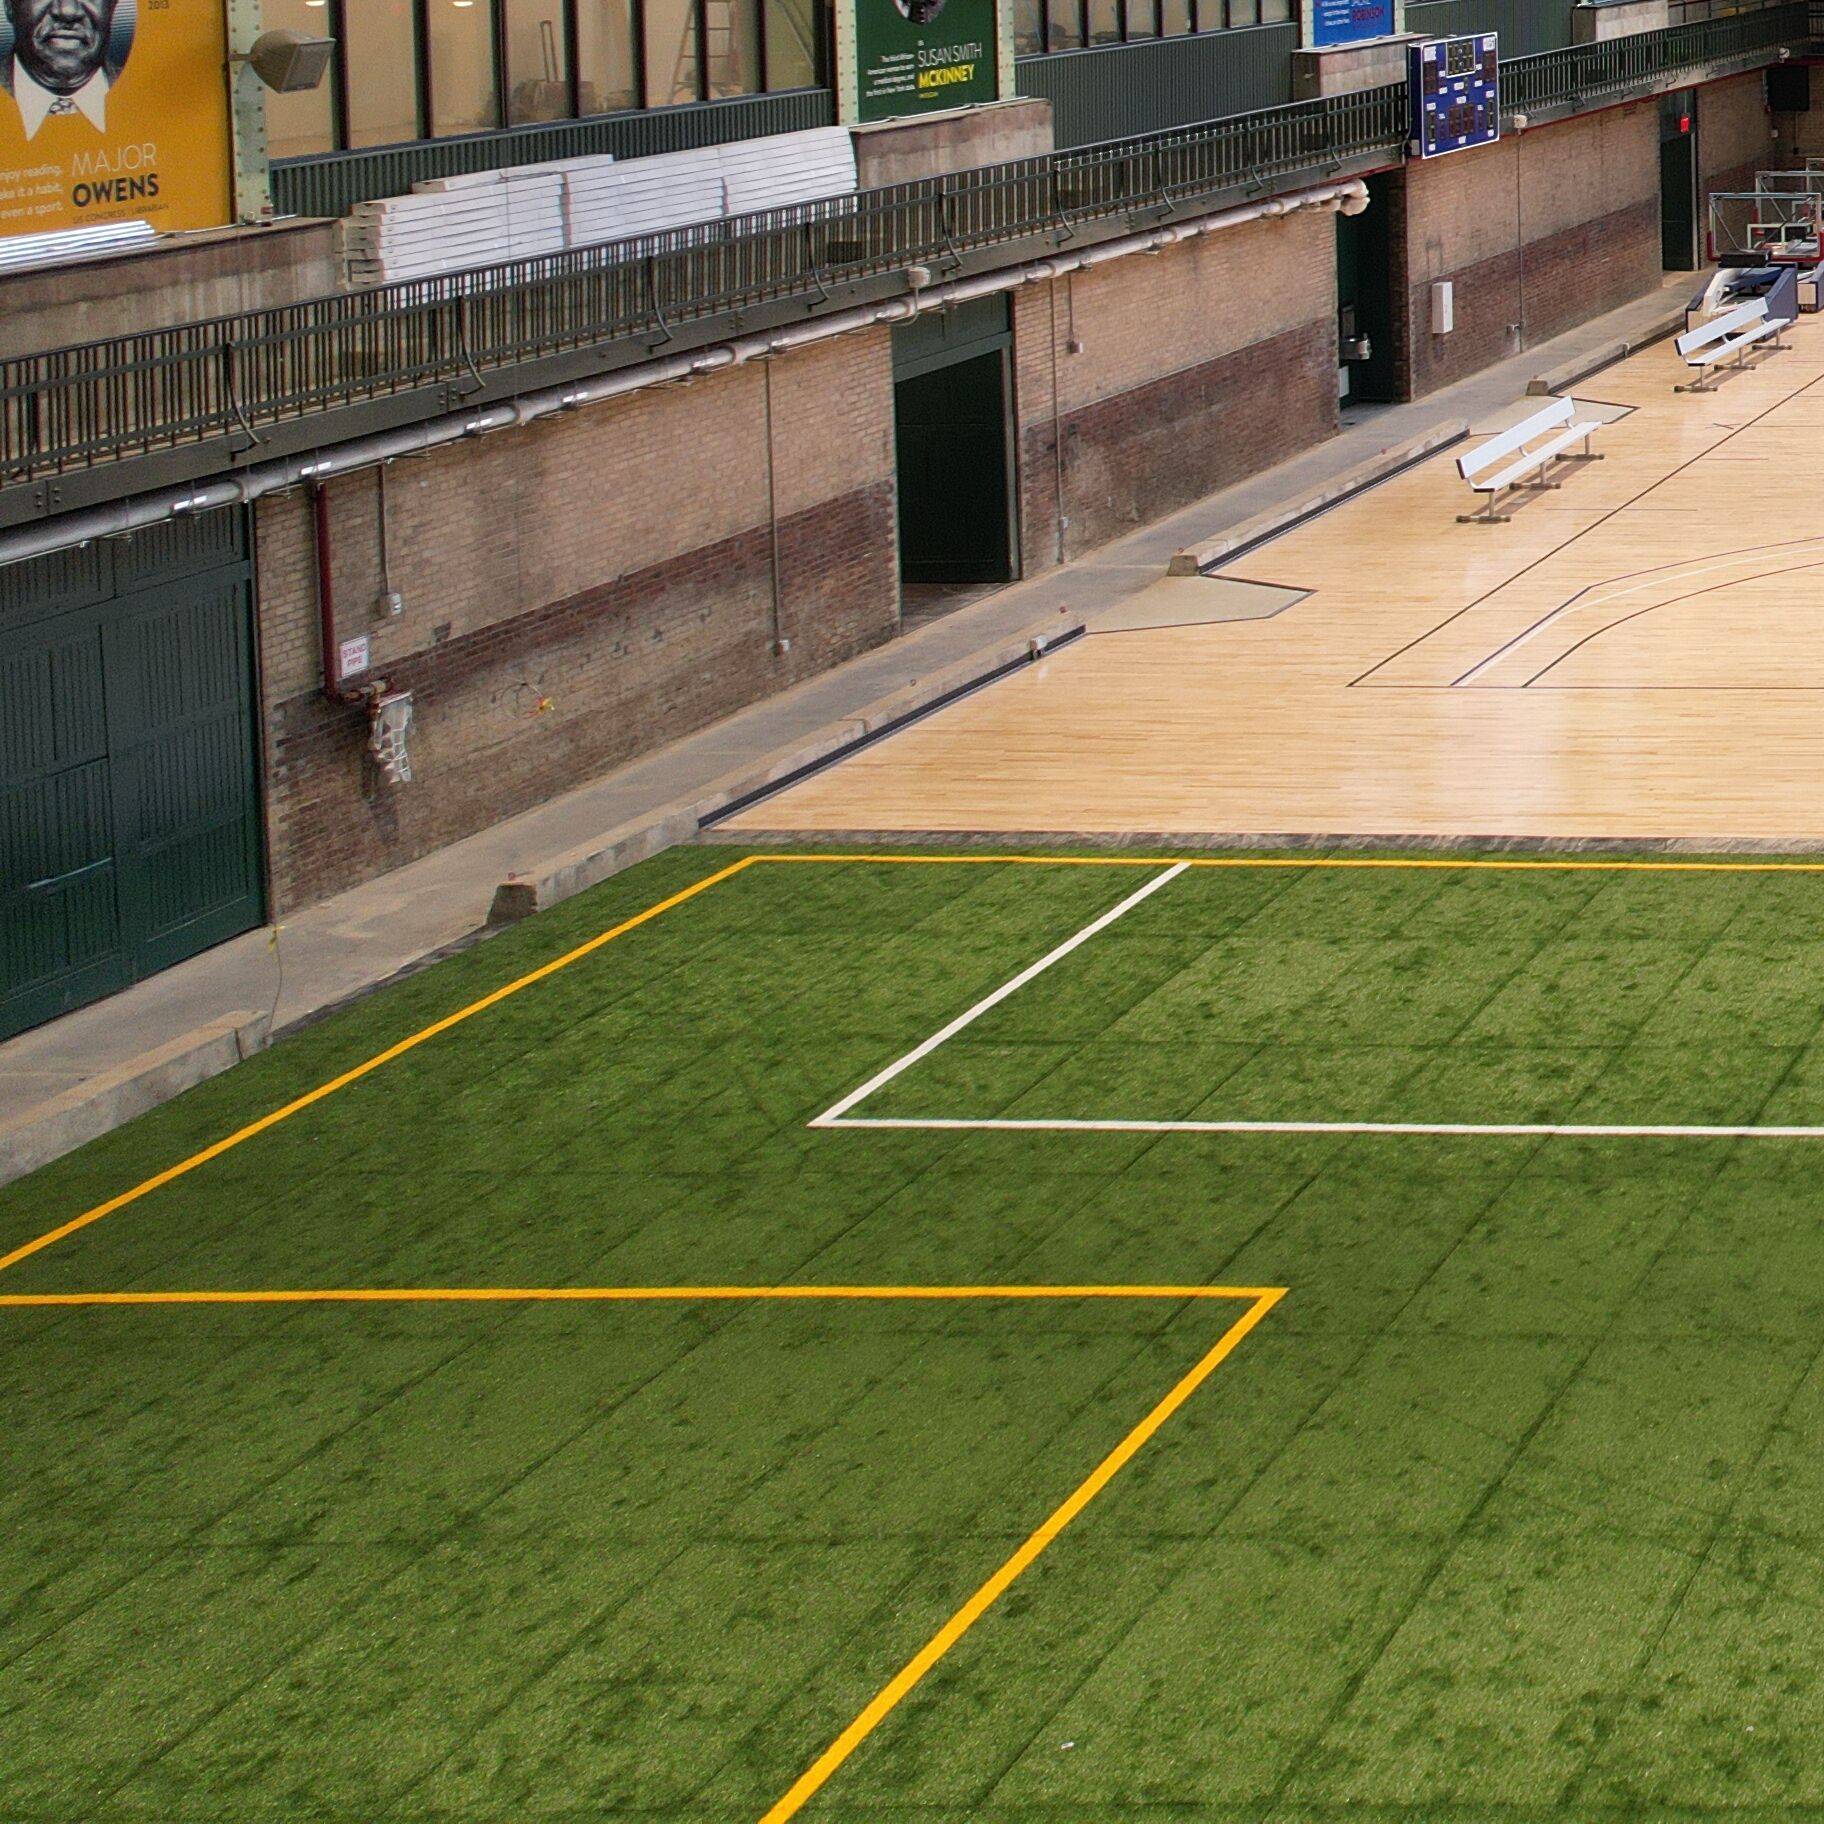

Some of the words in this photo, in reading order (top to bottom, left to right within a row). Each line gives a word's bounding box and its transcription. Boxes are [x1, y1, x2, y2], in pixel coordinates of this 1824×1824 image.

[918, 46, 952, 68] SUSAN
[952, 42, 982, 63] SMITH
[918, 63, 975, 89] MCKINNEY
[72, 143, 157, 177] MAJOR
[72, 172, 160, 208] OWENS
[343, 643, 368, 658] STAND
